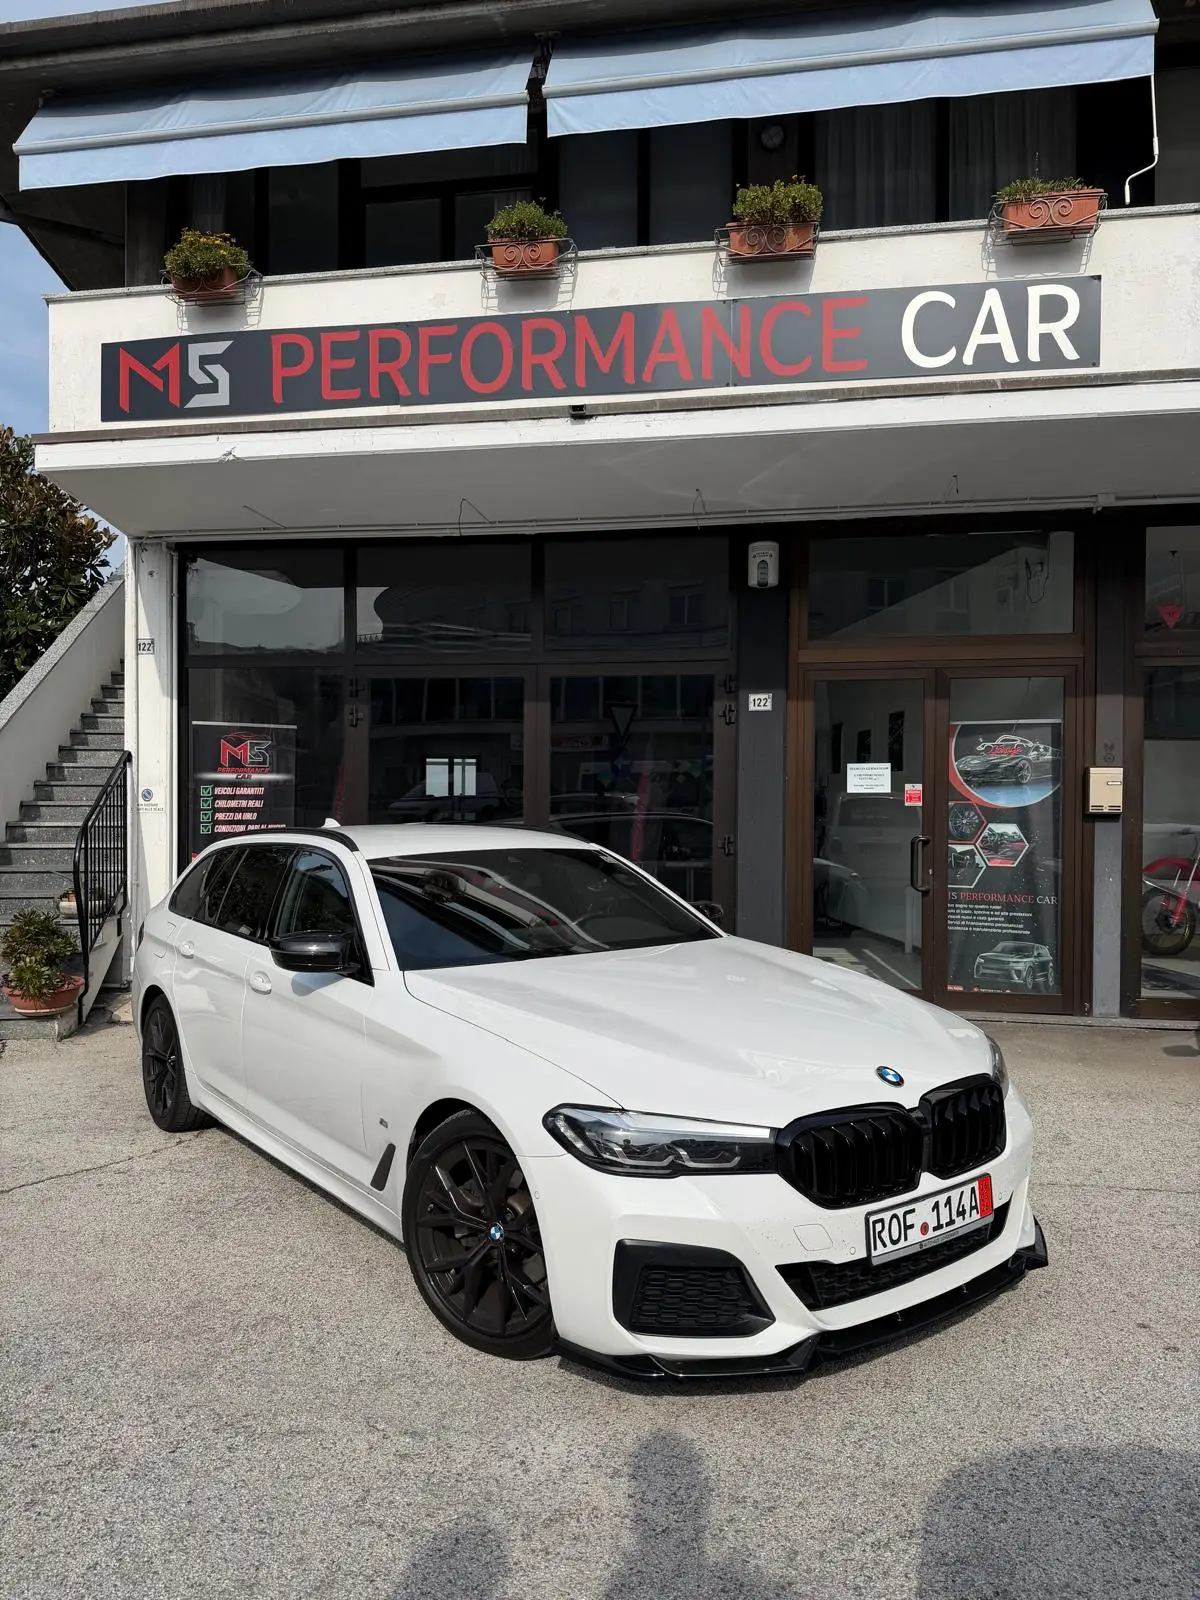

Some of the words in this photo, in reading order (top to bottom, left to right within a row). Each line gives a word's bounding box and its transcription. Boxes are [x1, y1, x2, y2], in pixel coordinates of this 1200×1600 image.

[271, 297, 868, 404] PERFORMANCE
[901, 283, 1081, 368] CAR
[217, 766, 270, 774] PERFORMANCE
[214, 787, 235, 795] VEICOLI
[236, 787, 264, 795] GARANTITI
[214, 800, 247, 808] CHILOMETRI
[247, 800, 264, 808] REALI
[214, 812, 234, 821] PREZZI
[234, 812, 242, 821] DA
[960, 892, 1034, 903] PERFORMANCE
[1036, 896, 1058, 905] CAR
[872, 1208, 916, 1251] ROF
[931, 1185, 979, 1232] 114A
